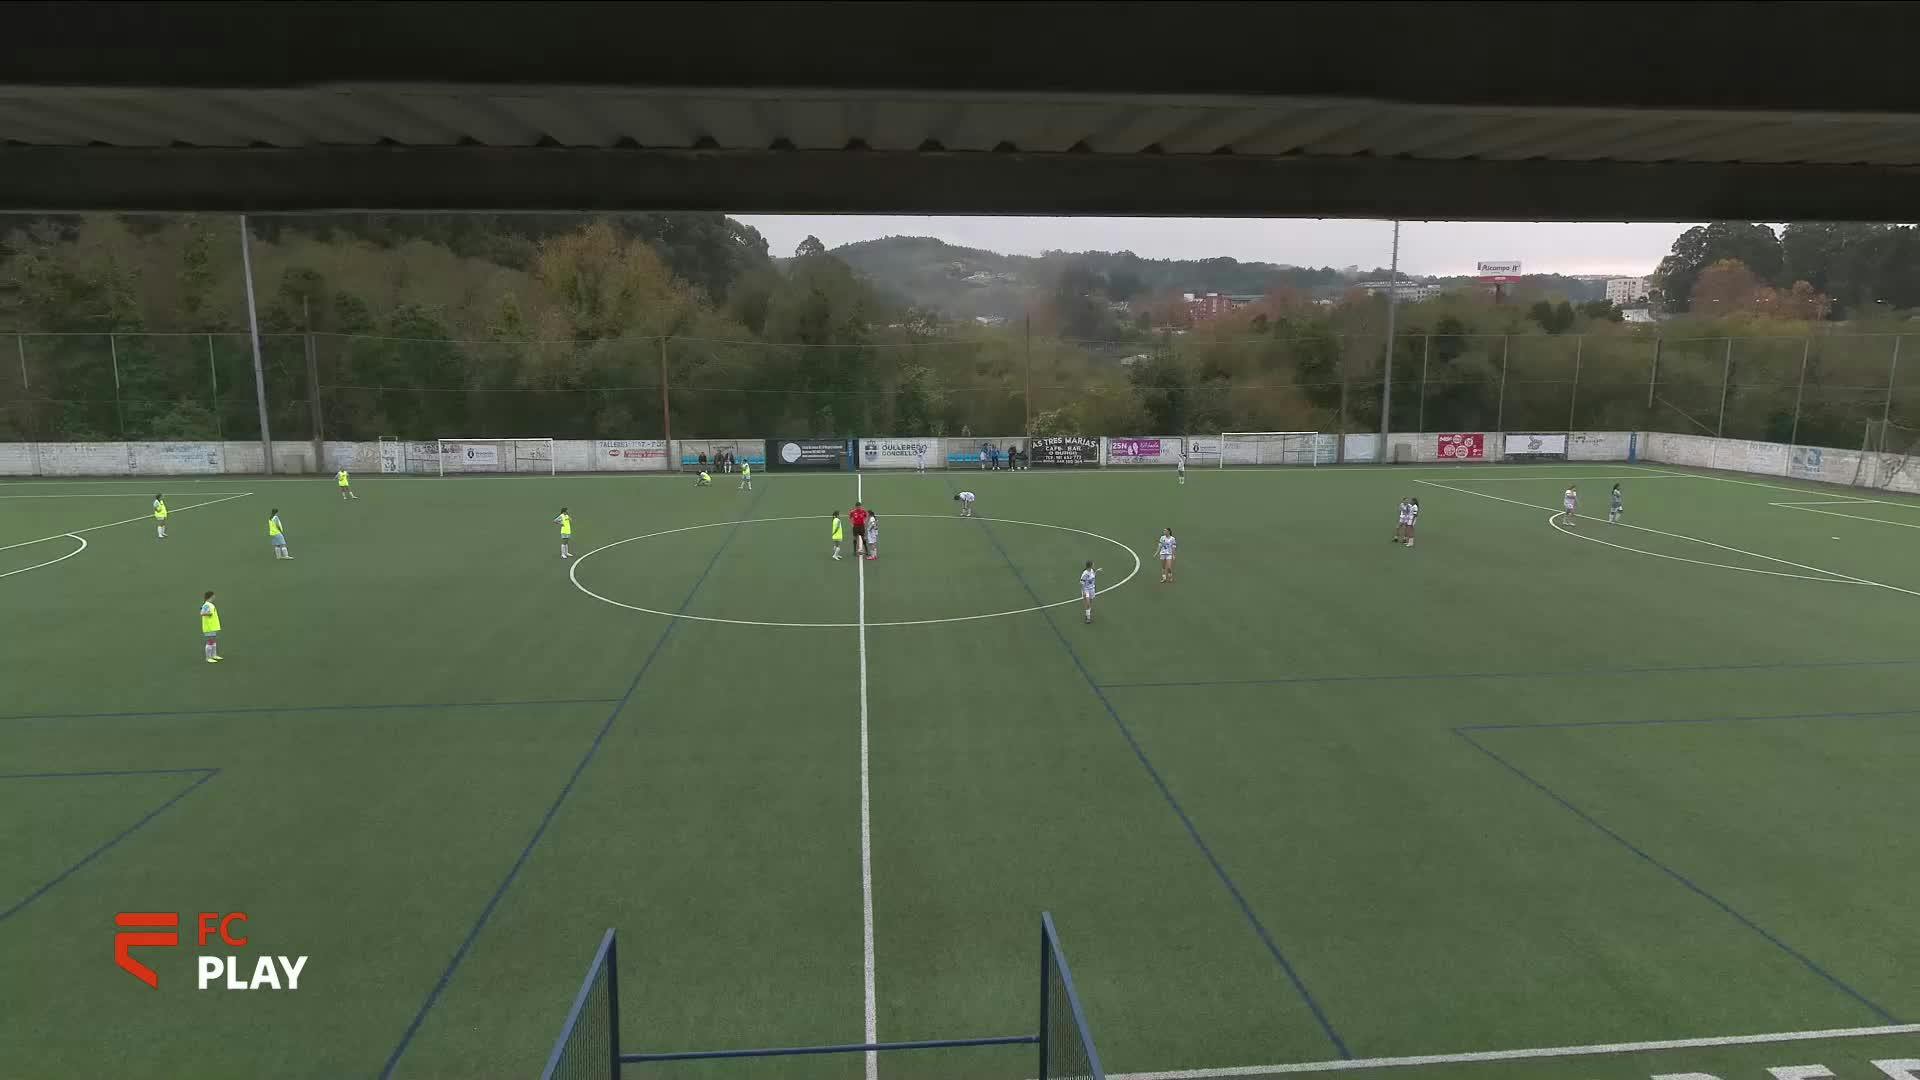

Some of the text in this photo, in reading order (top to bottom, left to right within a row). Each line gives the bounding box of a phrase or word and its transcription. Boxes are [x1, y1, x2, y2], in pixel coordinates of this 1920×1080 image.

[1032, 436, 1097, 449] AS TRES MARIAS
[1112, 442, 1128, 450] 25N
